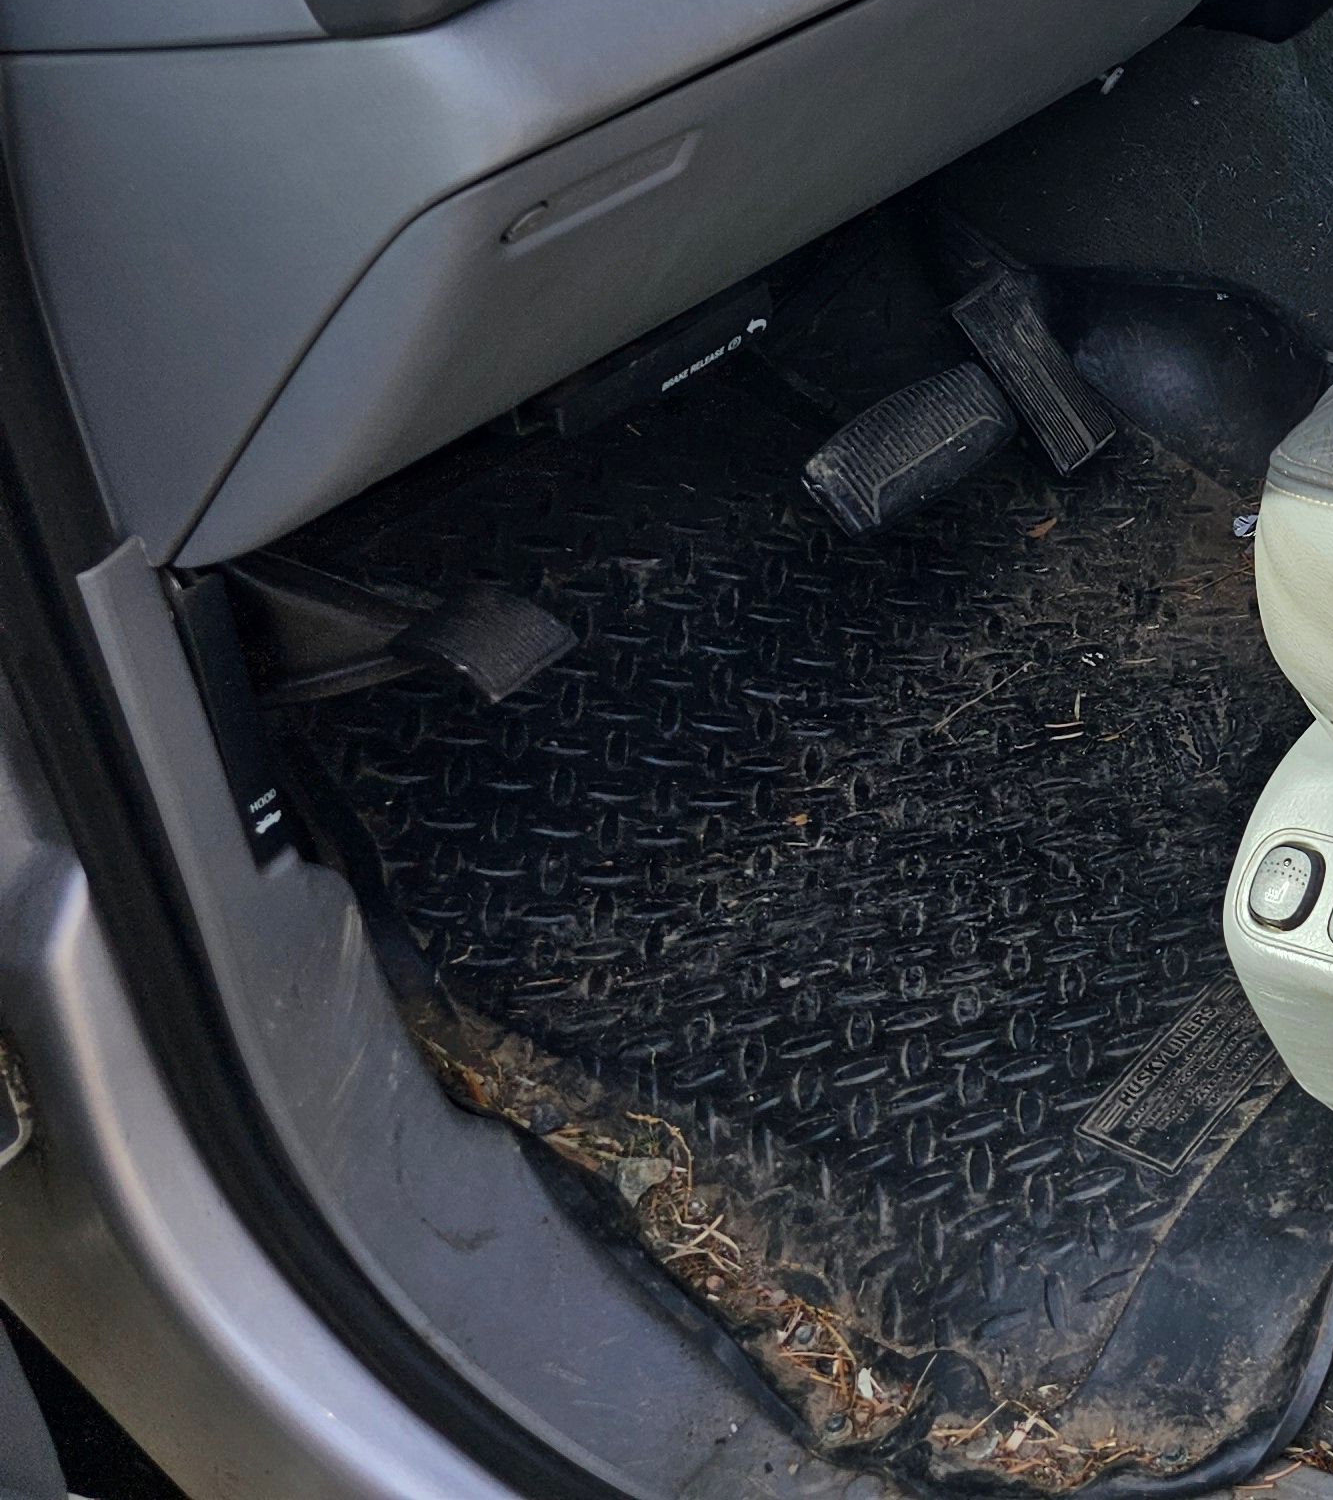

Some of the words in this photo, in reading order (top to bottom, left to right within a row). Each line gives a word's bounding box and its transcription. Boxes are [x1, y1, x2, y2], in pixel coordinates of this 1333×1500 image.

[662, 368, 690, 392] BRAKE
[690, 345, 725, 375] RELEASE
[250, 787, 277, 813] HOOD
